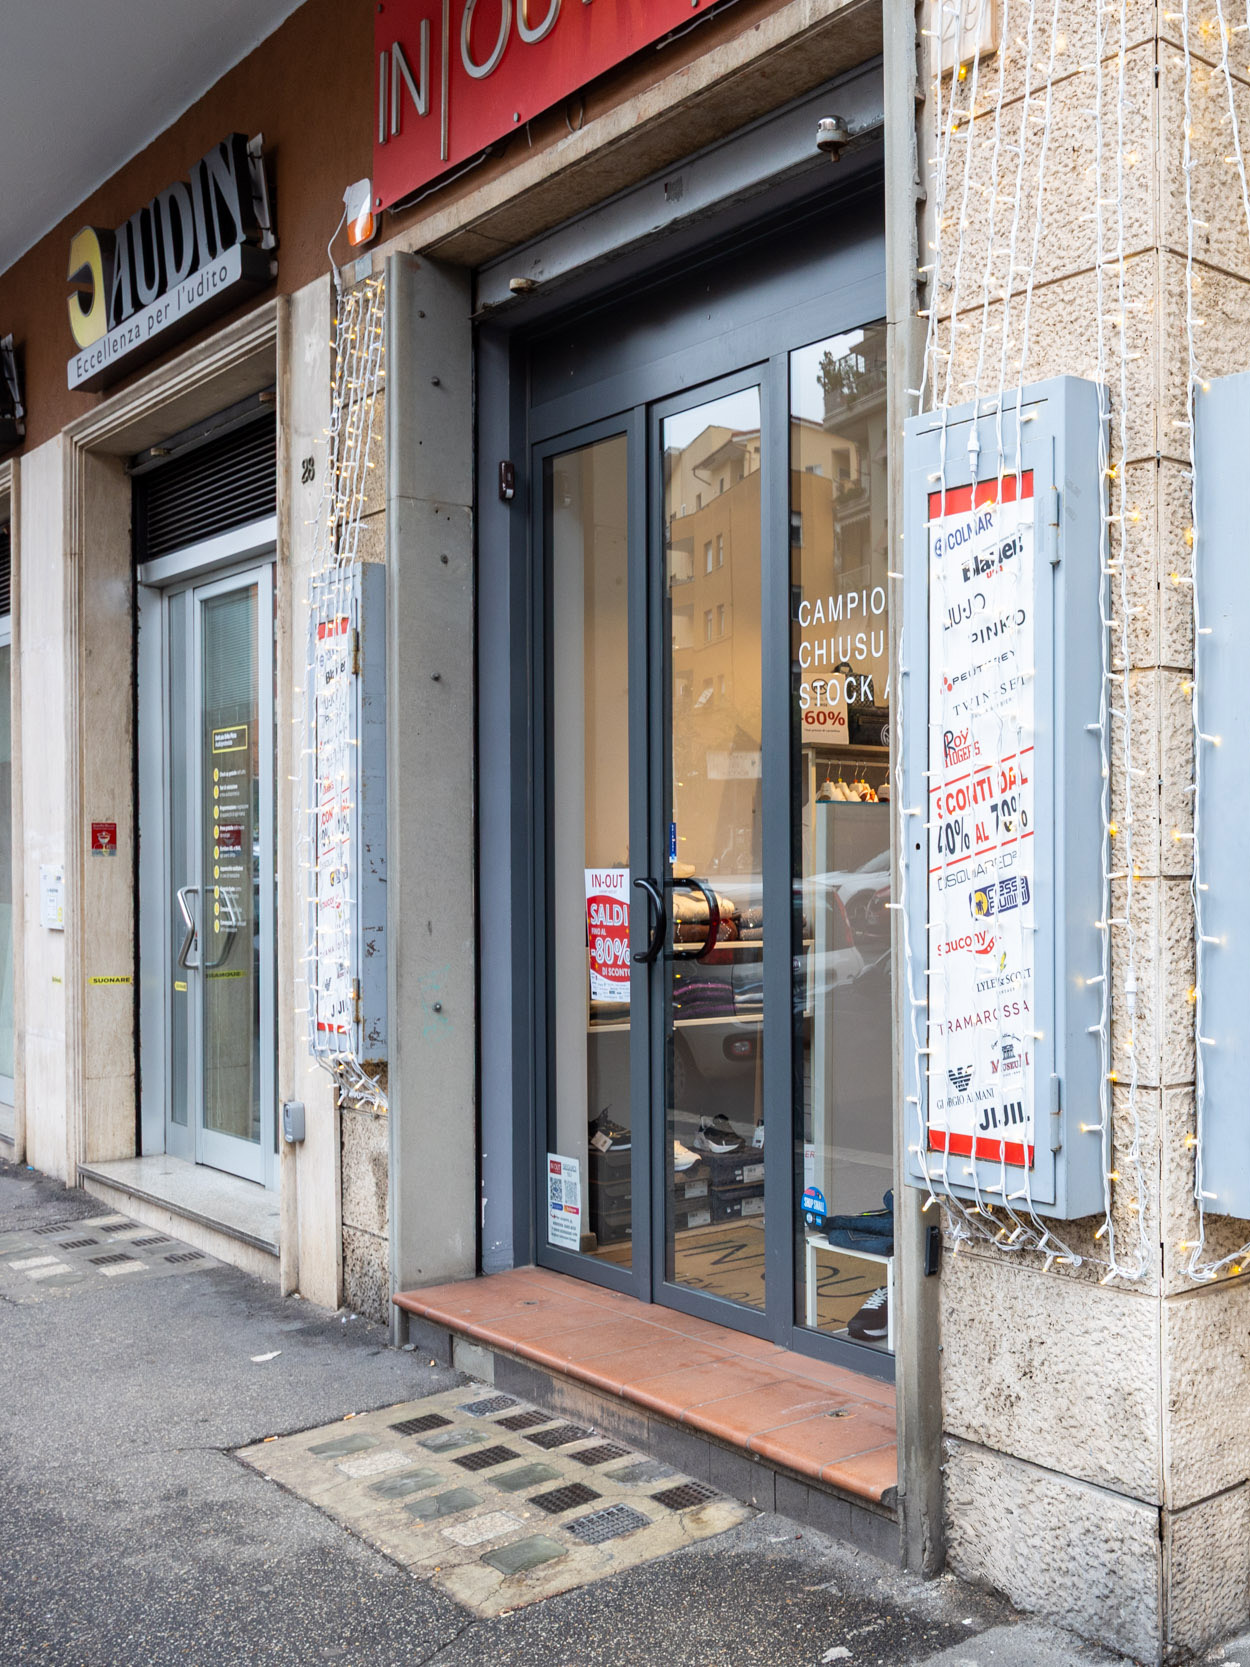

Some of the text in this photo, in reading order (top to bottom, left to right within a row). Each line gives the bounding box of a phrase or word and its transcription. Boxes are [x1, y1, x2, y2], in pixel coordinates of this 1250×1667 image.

[108, 133, 247, 331] AUDIN
[76, 264, 228, 378] Eccellenza per l'udito
[302, 456, 315, 485] 28
[798, 586, 886, 628] CAMPIO
[798, 630, 884, 668] CHIUSU
[798, 674, 874, 709] STOCK
[800, 710, 845, 727] -60%
[975, 821, 990, 845] AL
[591, 873, 624, 889] IN-OUT
[590, 903, 629, 927] SALDI
[591, 937, 631, 965] -80%
[804, 1196, 814, 1208] SHOP
